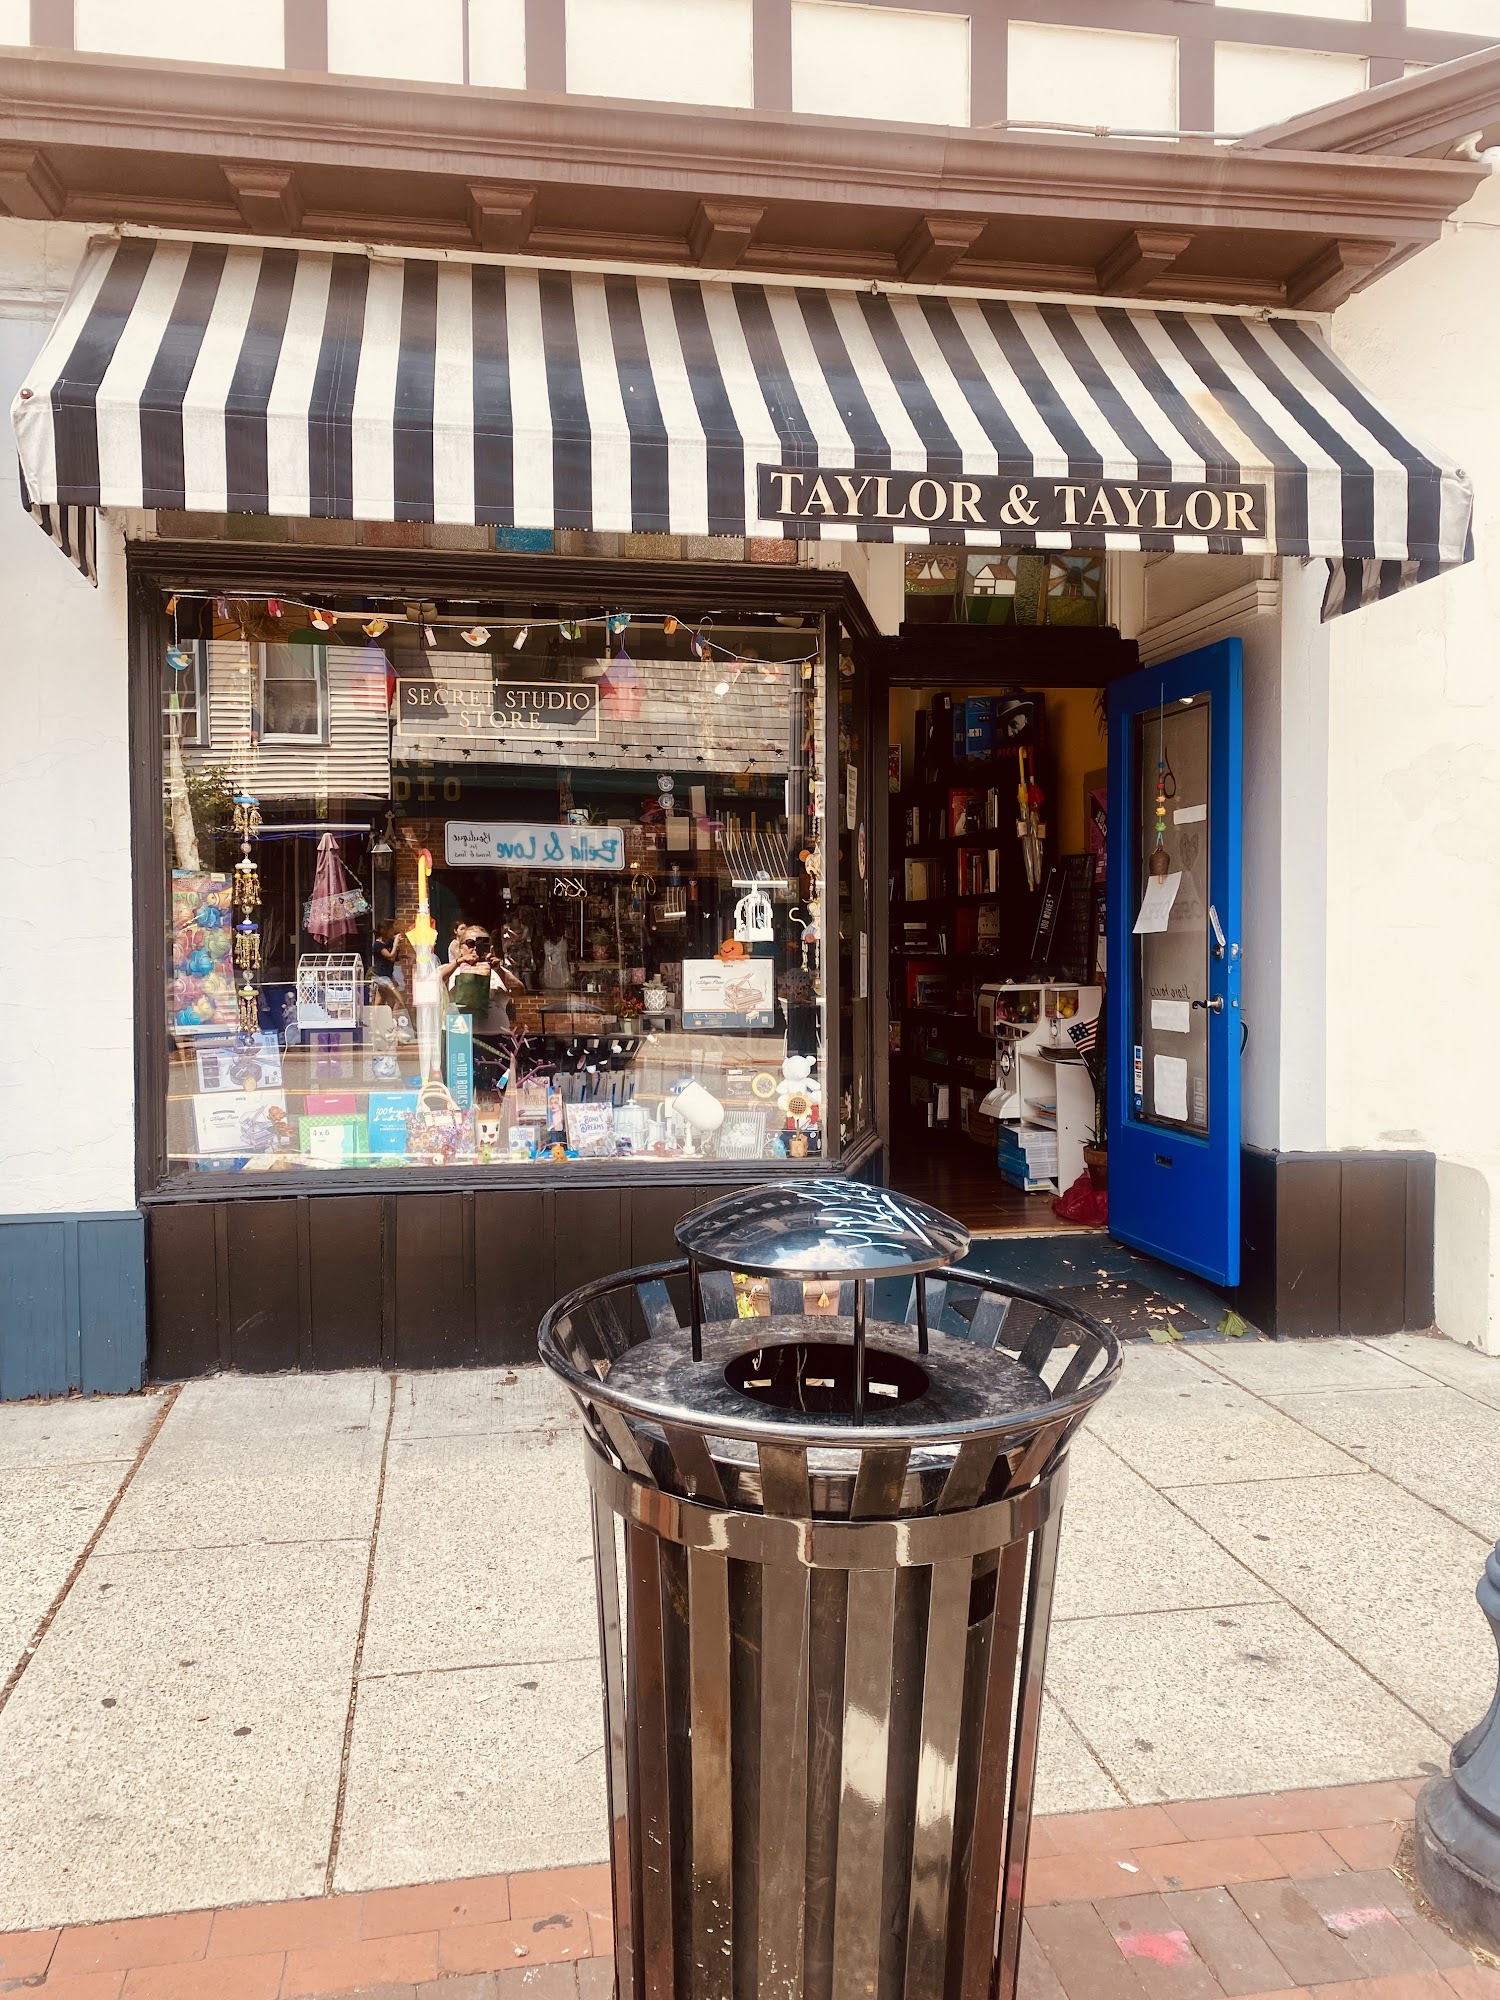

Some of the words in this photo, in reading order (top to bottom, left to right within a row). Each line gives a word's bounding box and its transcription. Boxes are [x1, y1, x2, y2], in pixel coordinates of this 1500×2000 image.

[769, 471, 987, 524] TAYLOR
[1000, 483, 1040, 526] &
[1055, 484, 1259, 532] TAYLOR
[406, 687, 496, 708] SECRET
[504, 690, 590, 711] STUDIO
[459, 710, 543, 730] STORE
[457, 1062, 468, 1077] 100
[457, 1080, 468, 1105] BOOKS
[580, 1123, 605, 1134] DREAMS
